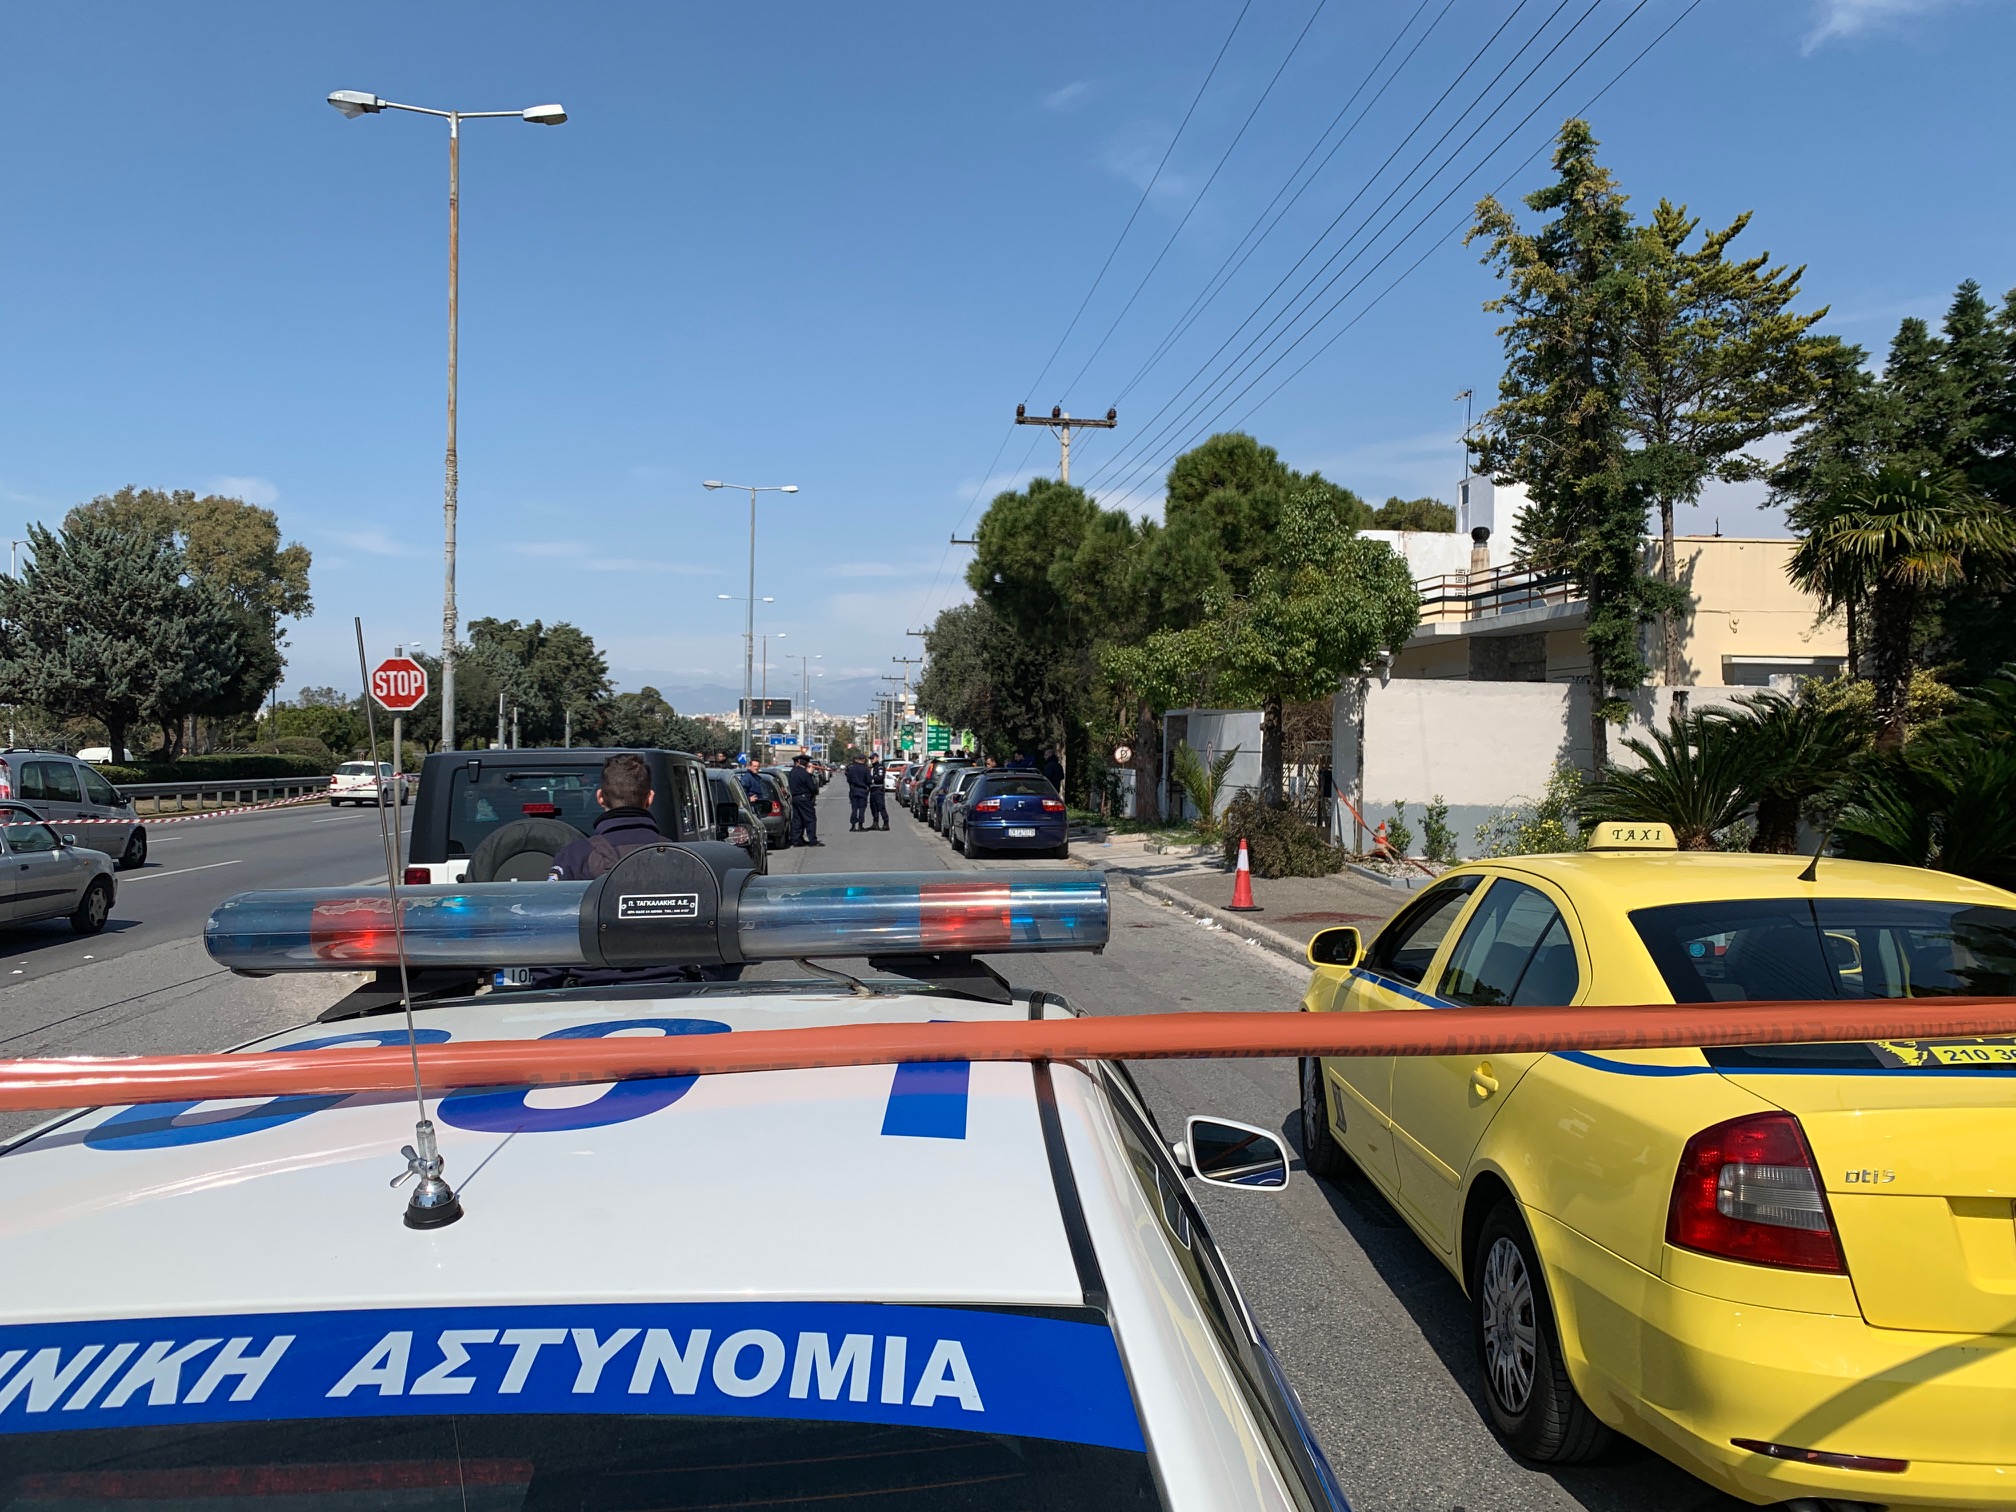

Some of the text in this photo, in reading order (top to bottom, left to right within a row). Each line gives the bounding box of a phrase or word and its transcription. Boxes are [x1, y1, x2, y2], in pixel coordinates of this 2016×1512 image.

[375, 670, 422, 697] STOP
[1612, 828, 1661, 841] TAXI
[1943, 1049, 1990, 1061] 210
[325, 1328, 985, 1412] ΑΣΤΥΝΟΜΙΑ
